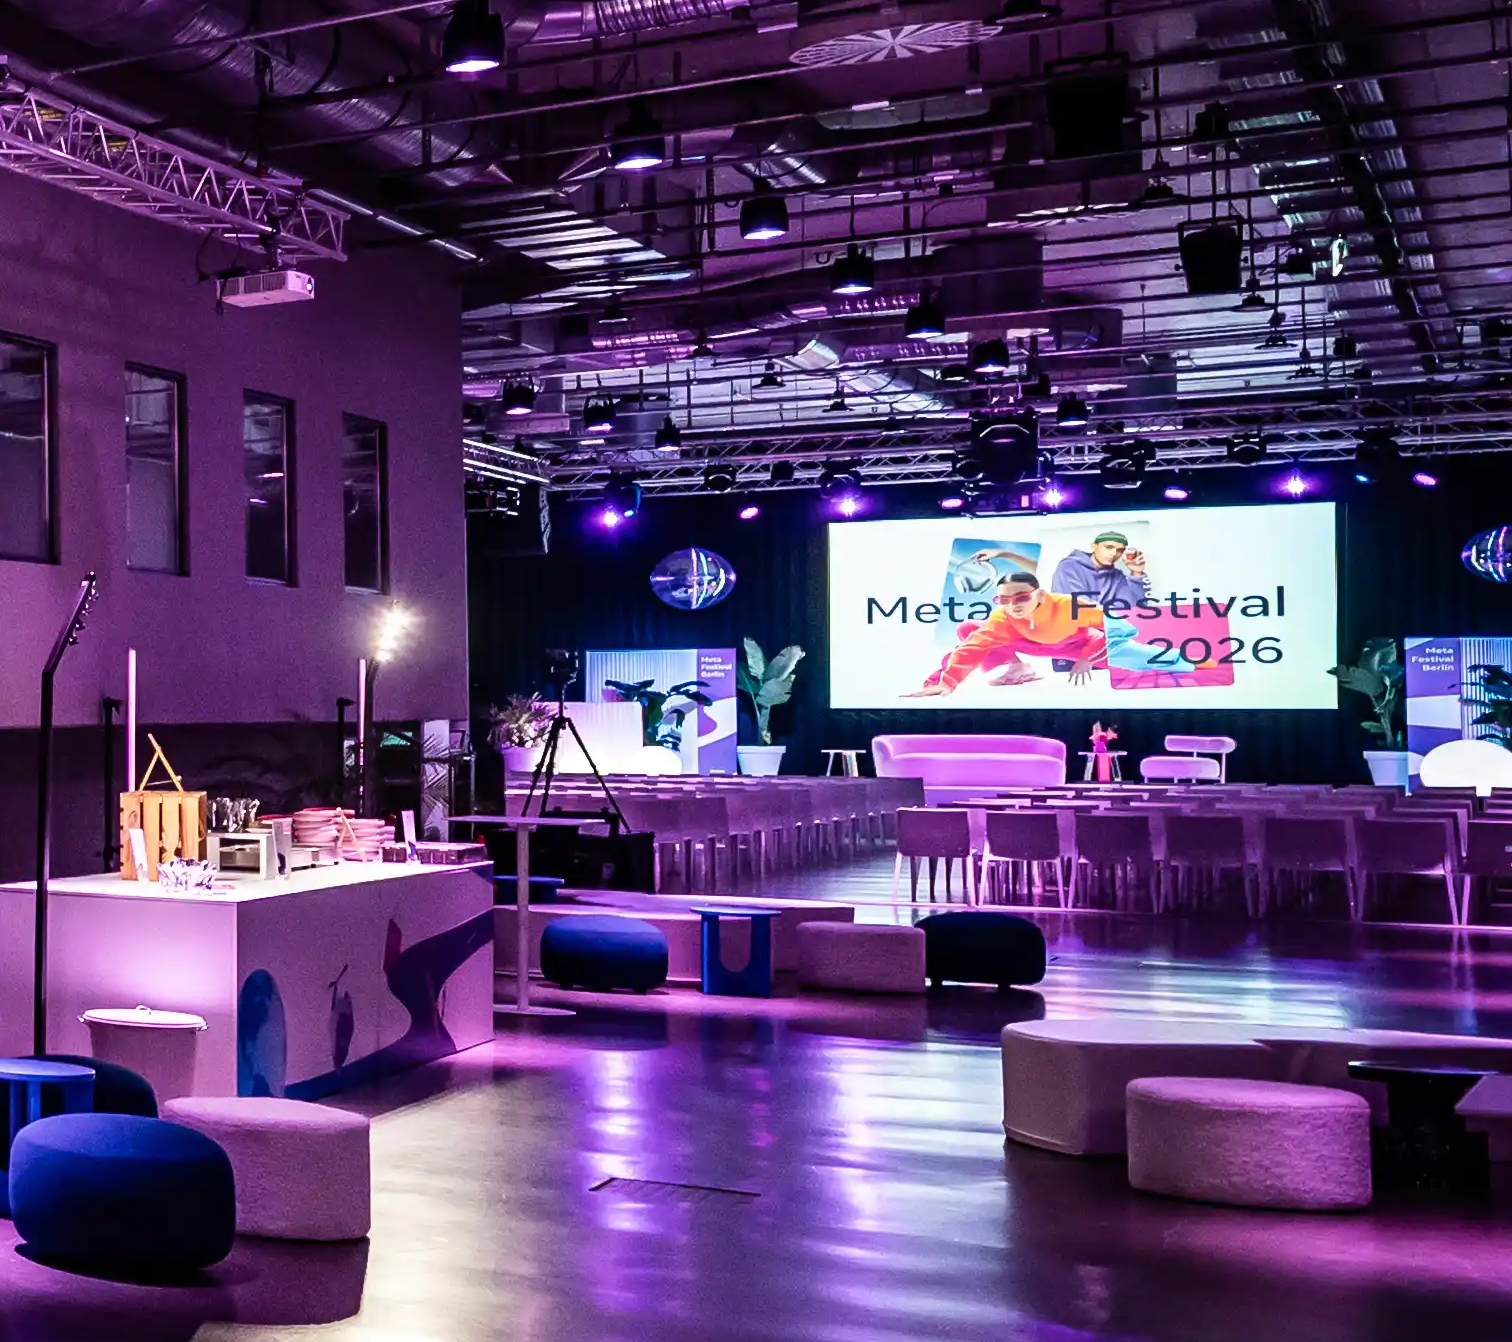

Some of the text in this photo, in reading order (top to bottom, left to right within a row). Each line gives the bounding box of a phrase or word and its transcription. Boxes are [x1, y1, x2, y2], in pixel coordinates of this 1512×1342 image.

[866, 585, 1285, 625] Meta Festival
[1146, 635, 1284, 665] 2026
[1411, 655, 1454, 663] Festival
[1422, 664, 1454, 672] Berlin
